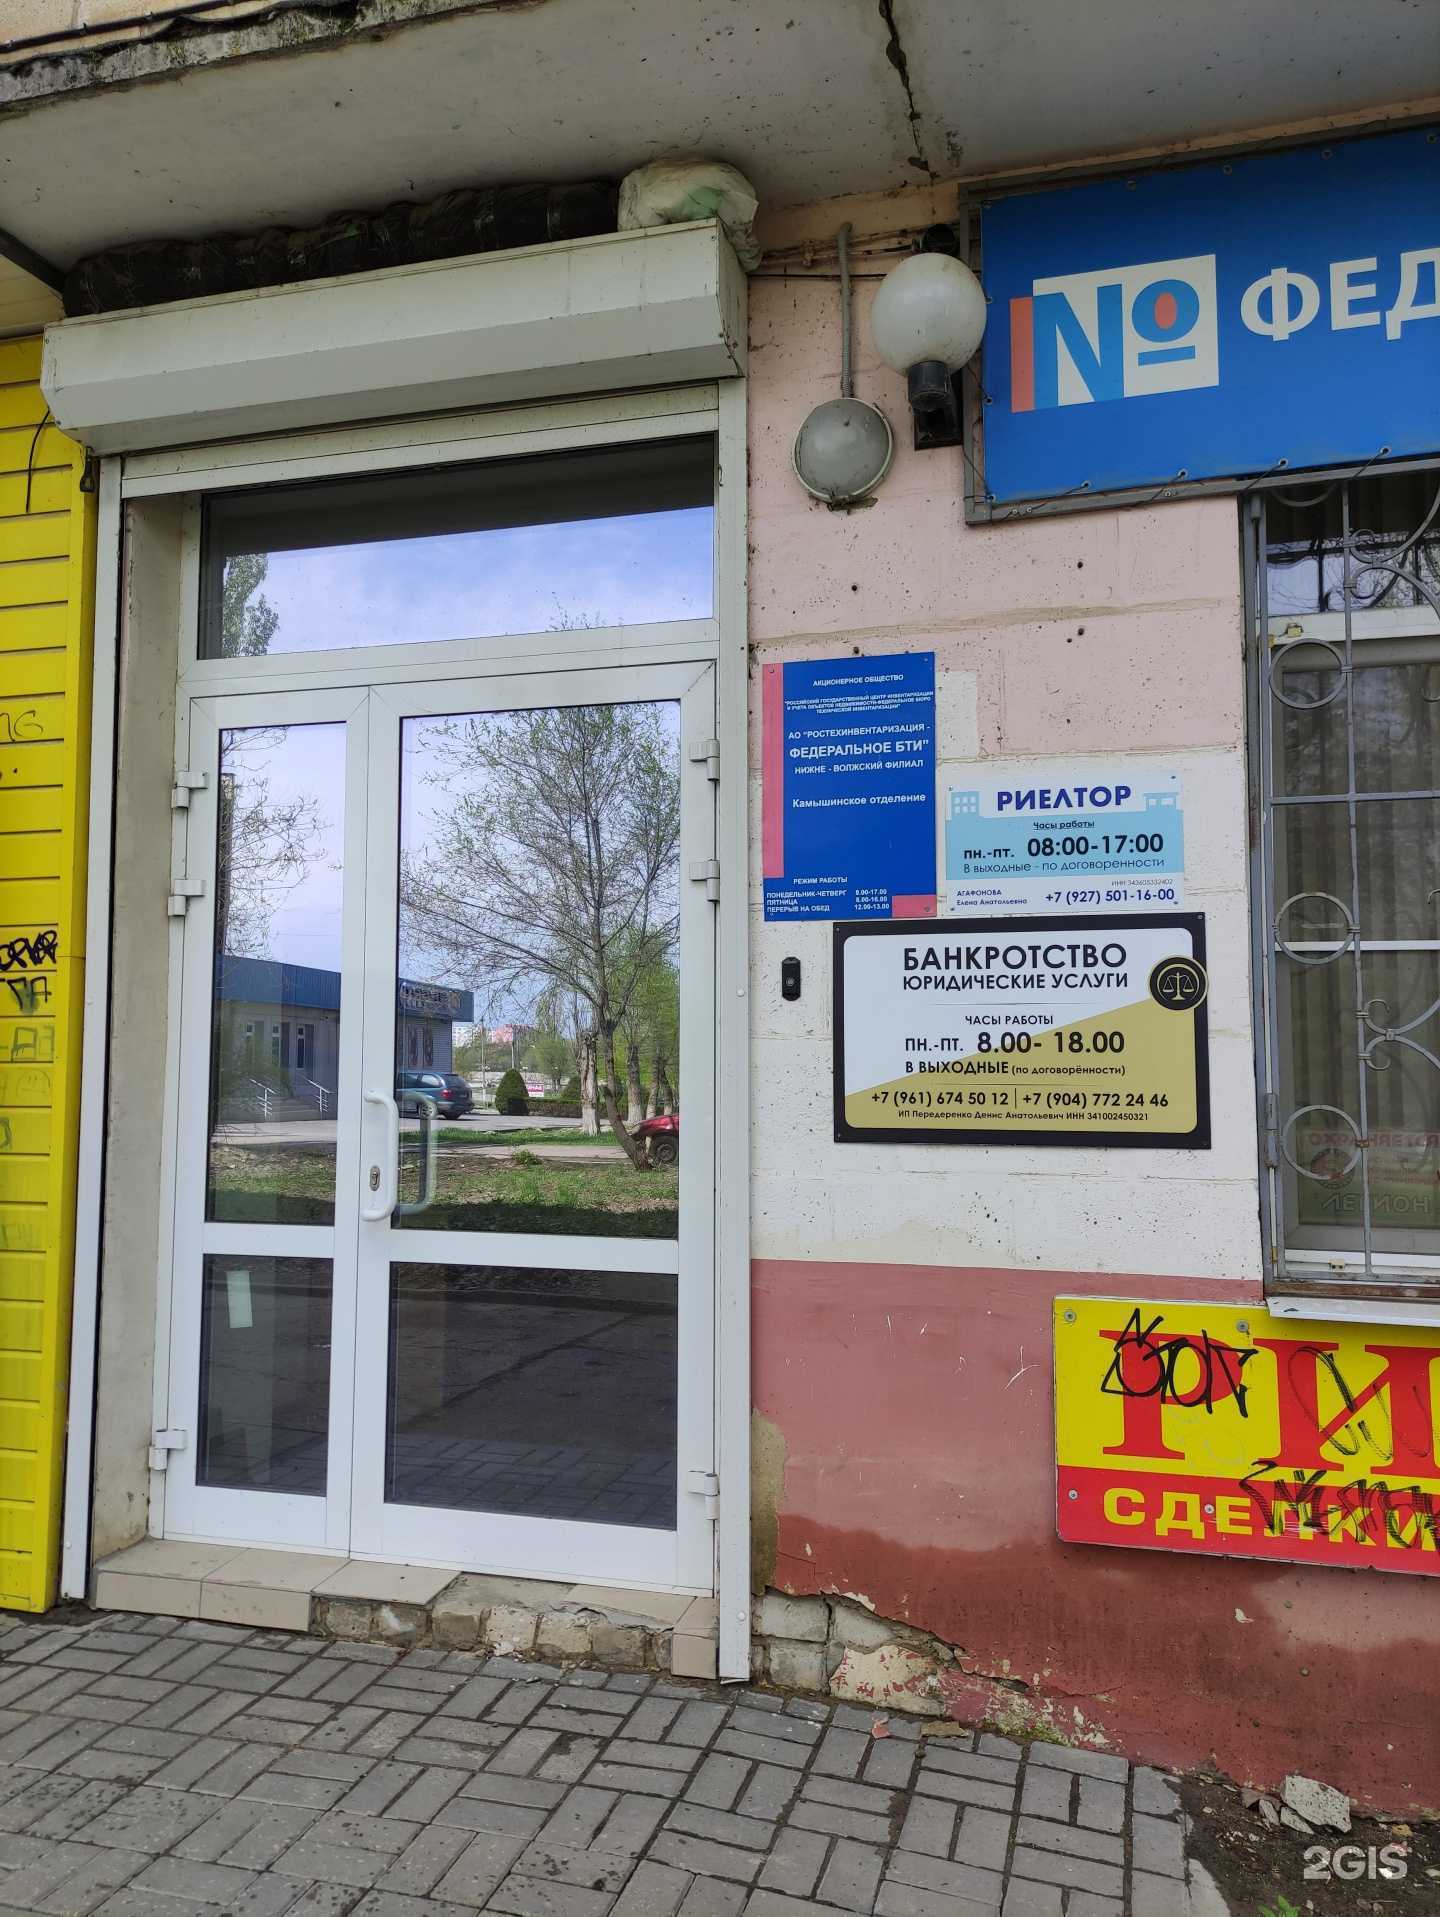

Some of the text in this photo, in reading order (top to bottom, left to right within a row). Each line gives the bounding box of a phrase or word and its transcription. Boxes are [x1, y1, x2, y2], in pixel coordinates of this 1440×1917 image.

[1240, 247, 1440, 341] ФЕД
[813, 674, 904, 687] АКЦИОНЕРНОЕ ОБЩЕСТВО
[788, 731, 801, 740] АО
[803, 723, 924, 738] "РОСТЕХИНВЕНТАРИЗАЦИЯ
[789, 740, 929, 759] ФЕДЕРАЛЬНОЕ БТИ"
[794, 764, 826, 775] НИЖНЕ
[833, 762, 883, 773] ВОЛЖСКИЙ
[885, 759, 924, 769] ФИЛИАЛ
[792, 793, 926, 808] Камышинское отделение
[997, 785, 1131, 811] РИЕЛТОР
[1033, 820, 1095, 831] Часы работы
[1027, 833, 1164, 857] 08:00-17:00
[964, 863, 971, 873] В
[973, 863, 1031, 874] выходные
[1042, 862, 1058, 872] по
[1060, 858, 1165, 872] договоренности
[793, 876, 848, 885] РЕЖИМ РАБОТЫ
[767, 889, 847, 899] ПОНЕДЕЛЬНИК-ЧЕТВЕРГ
[957, 889, 1002, 897] АГАФОНОВА
[1045, 888, 1175, 905] +7 (927) 501-16-00
[767, 898, 798, 906] ПЯТНИЦА
[767, 905, 799, 913] ПЕРЕРЫВ
[811, 904, 830, 912] ОБЕД
[979, 898, 1028, 906] Анатольевна
[903, 943, 1127, 971] БАНКРОТСТВО
[903, 973, 1128, 992] ЮРИДИЧЕСКИЕ УСЛУГИ
[965, 1014, 1054, 1026] ЧАСЫ РАБОТЫ
[905, 1037, 964, 1053] ПН.-ПТ.
[1054, 1030, 1125, 1054] 18.00
[905, 1061, 1126, 1076] В ВЫХОДНЫЕ (по договорённости)
[872, 1091, 1169, 1109] +7 (961) 674 50 12 +7 (904) 772 24 46
[898, 1110, 1149, 1121] ИП Передеренко Денис Анатольевич ИНН 341002450321
